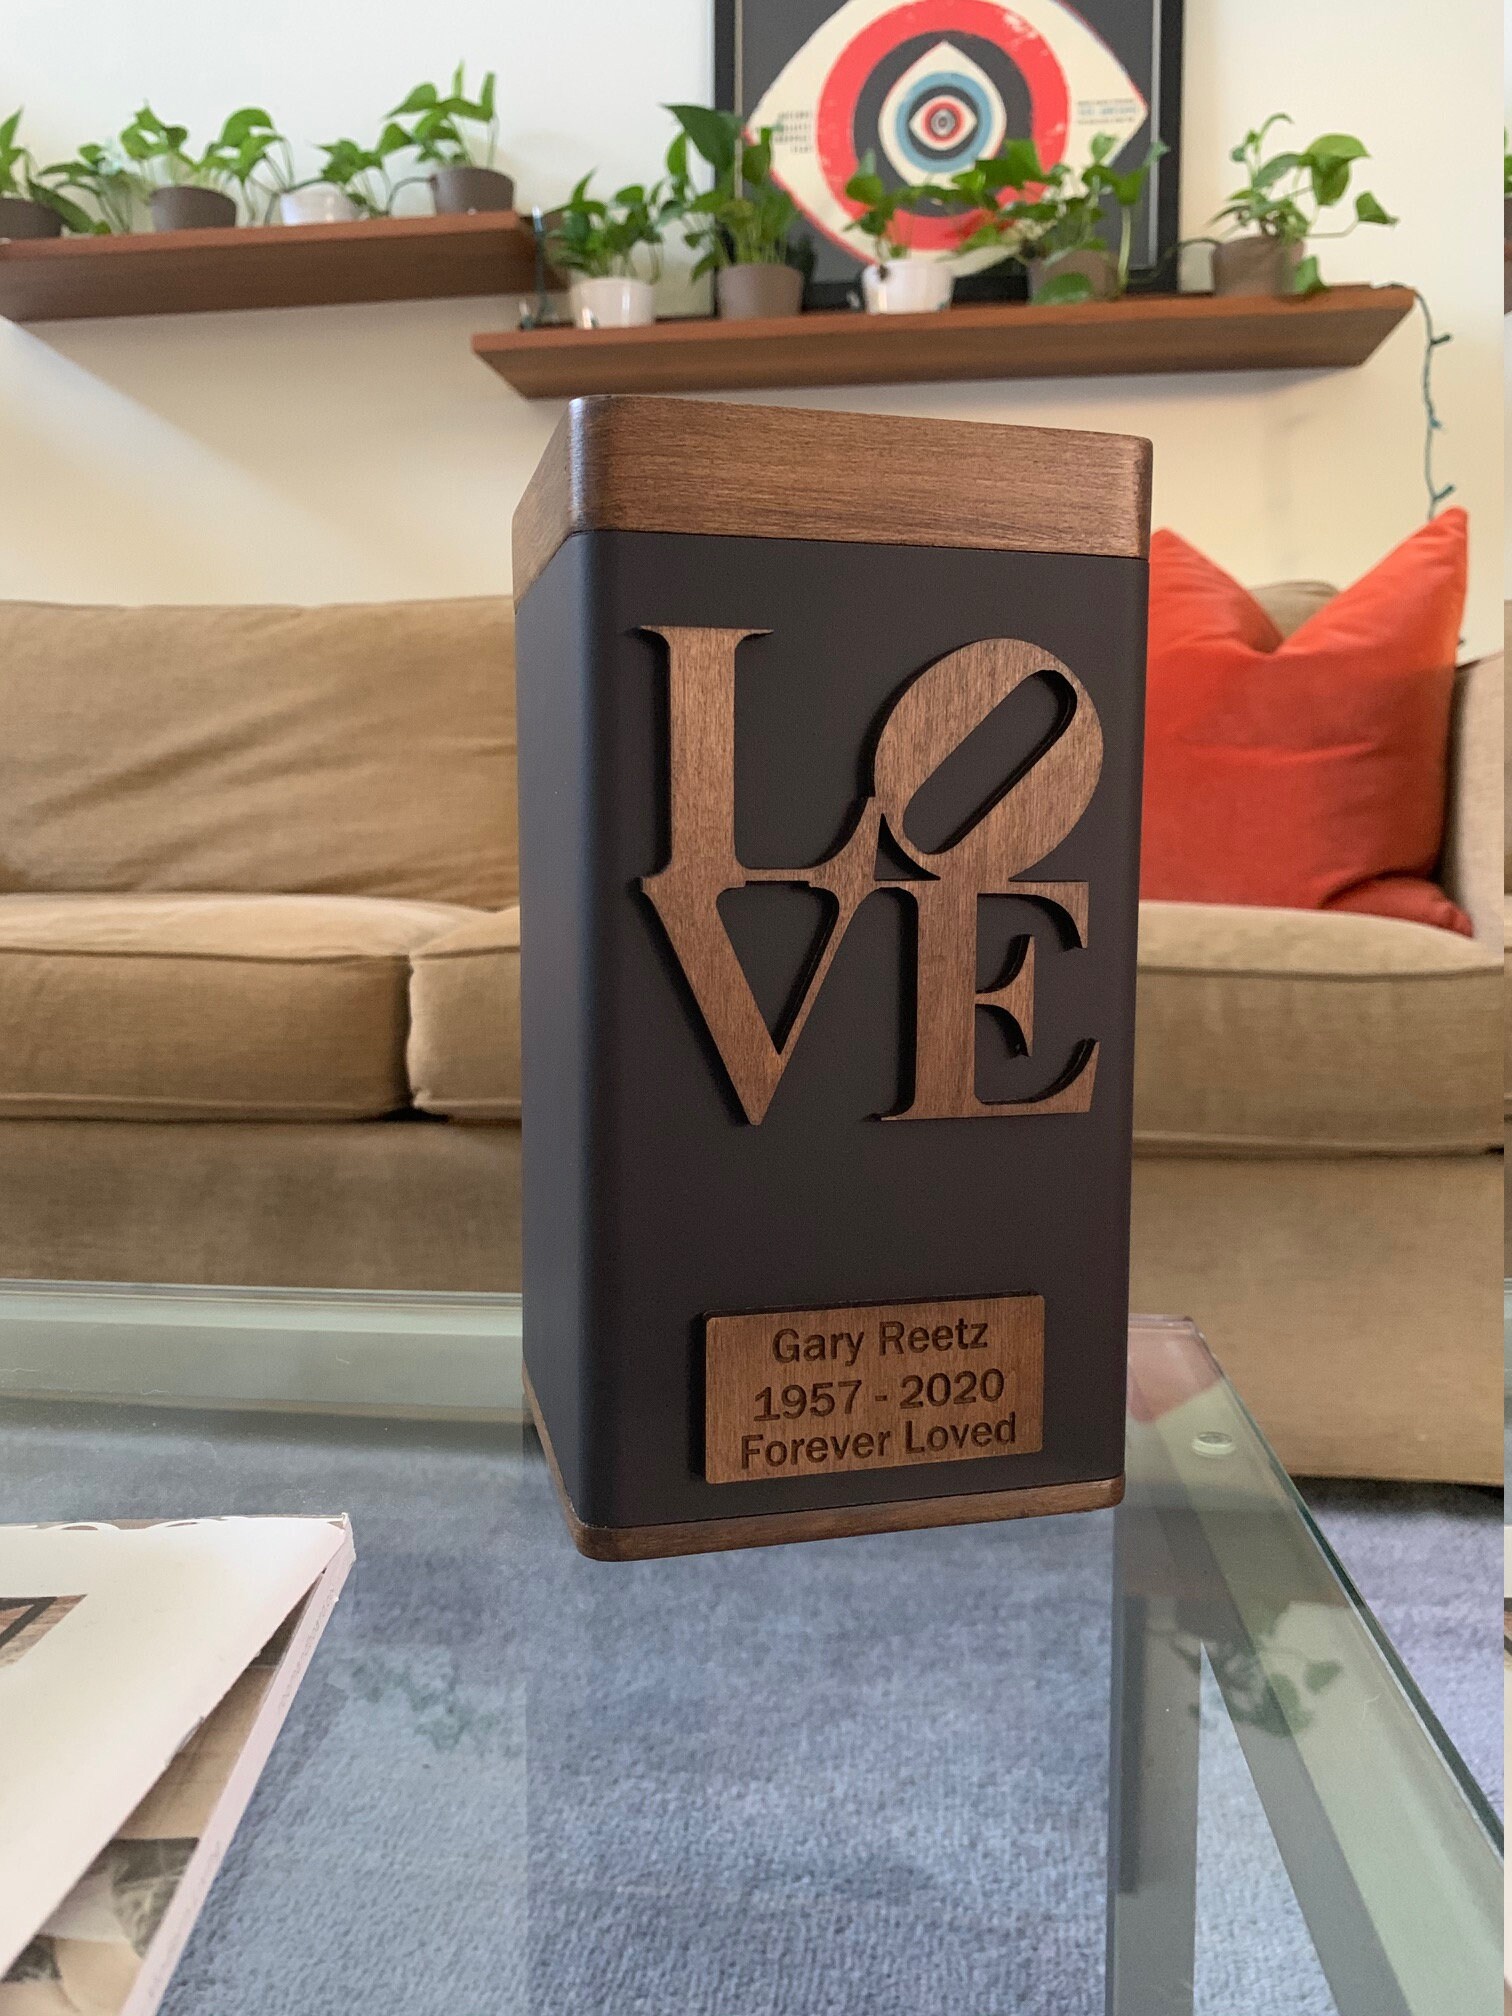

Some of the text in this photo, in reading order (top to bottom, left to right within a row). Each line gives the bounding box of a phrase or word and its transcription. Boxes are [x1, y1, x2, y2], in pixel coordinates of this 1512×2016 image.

[772, 1318, 989, 1366] Gary Reetz
[753, 1379, 862, 1422] 1957
[899, 1368, 1005, 1409] 2020
[741, 1412, 1017, 1470] Forever Loved
